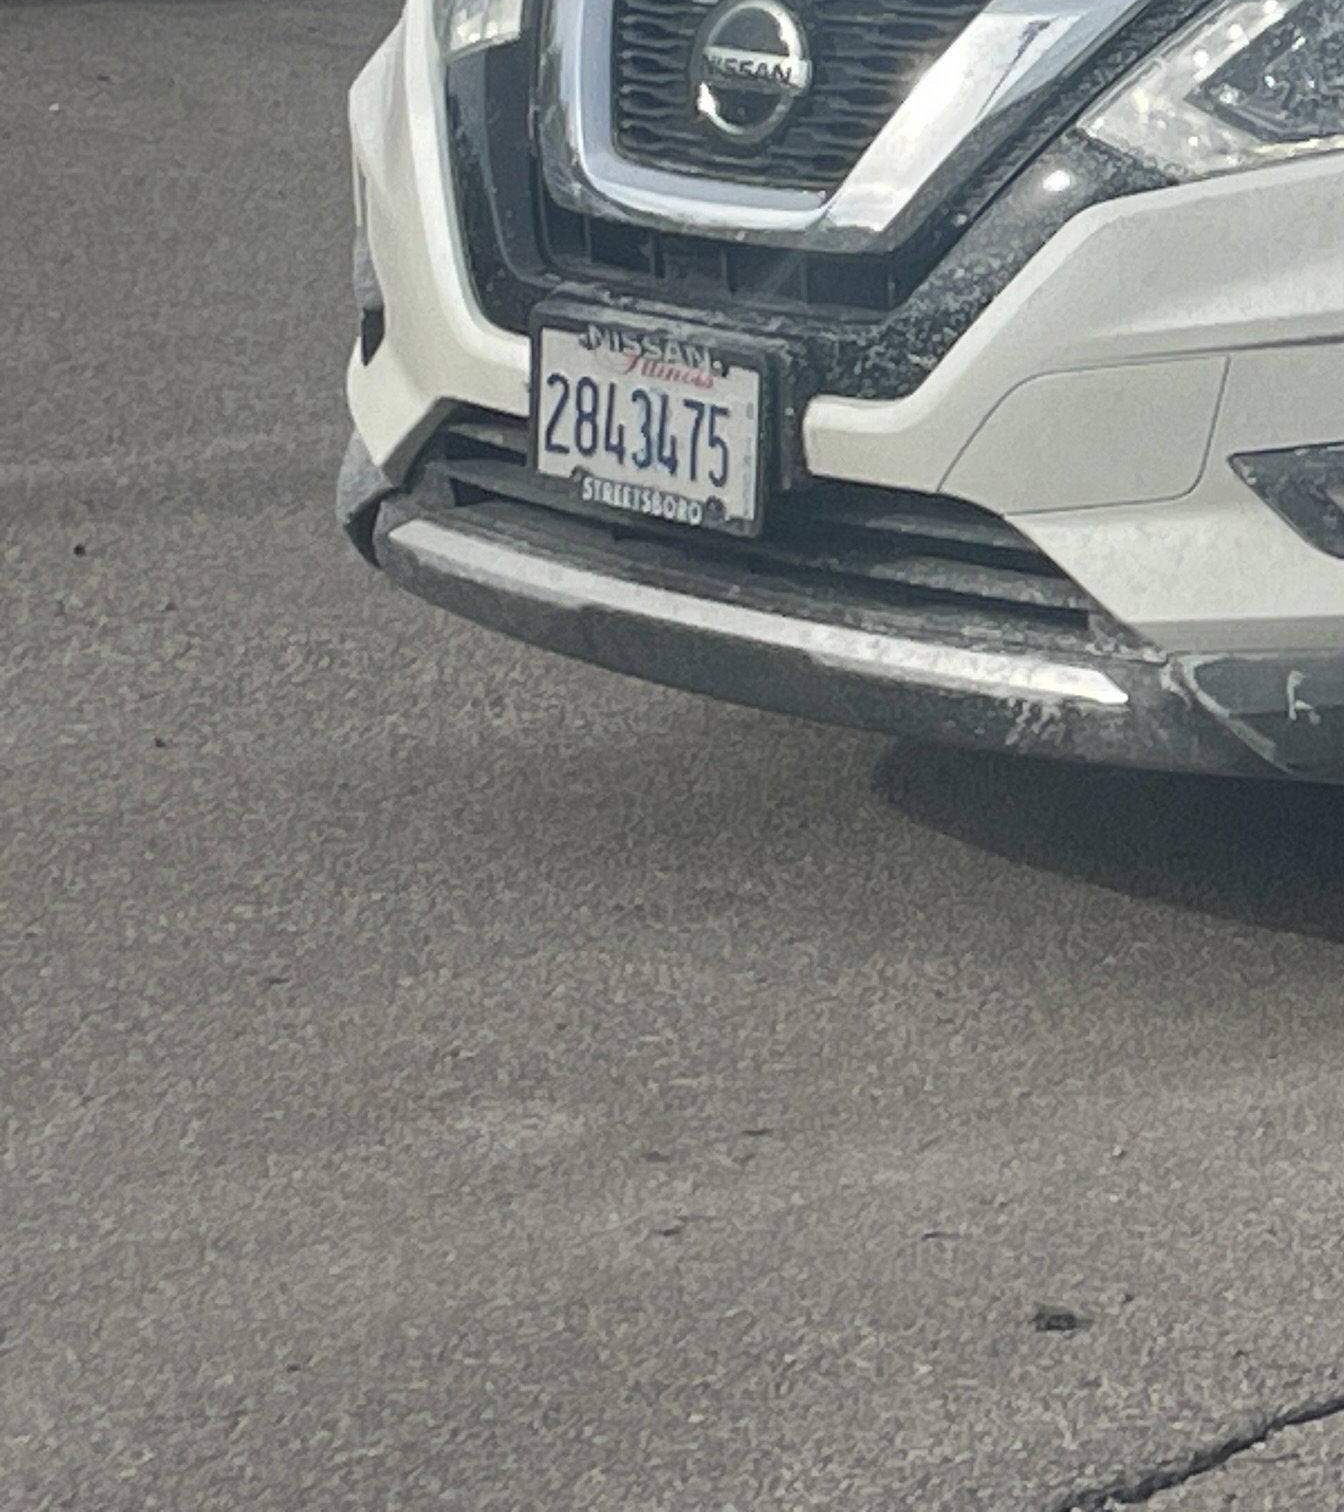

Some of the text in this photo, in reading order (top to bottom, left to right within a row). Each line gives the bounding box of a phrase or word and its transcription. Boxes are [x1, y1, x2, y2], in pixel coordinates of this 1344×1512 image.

[588, 323, 710, 376] NISSAN
[544, 373, 731, 488] 2843475
[582, 475, 702, 526] STREETSBORO
